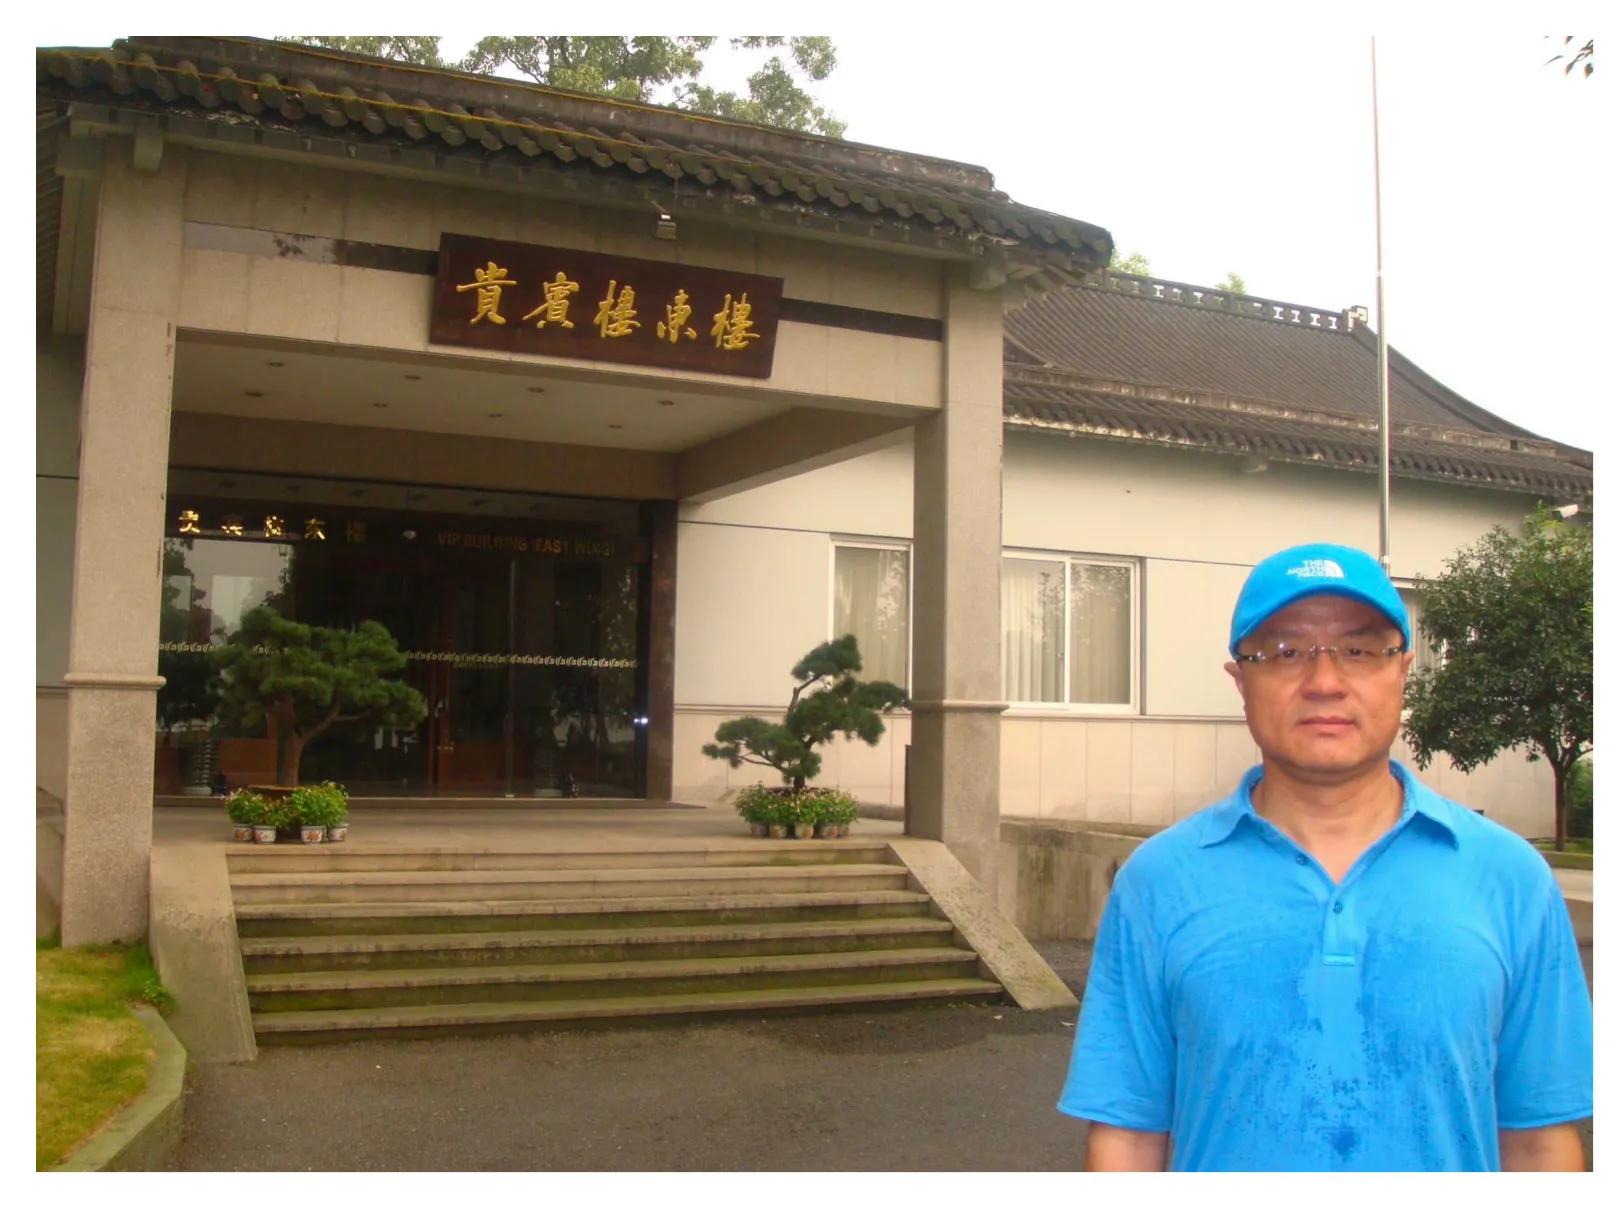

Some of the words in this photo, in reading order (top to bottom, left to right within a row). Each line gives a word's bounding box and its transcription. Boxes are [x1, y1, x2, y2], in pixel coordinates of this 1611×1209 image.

[455, 261, 761, 350] 貴賓樓東樓
[1302, 559, 1323, 567] THE
